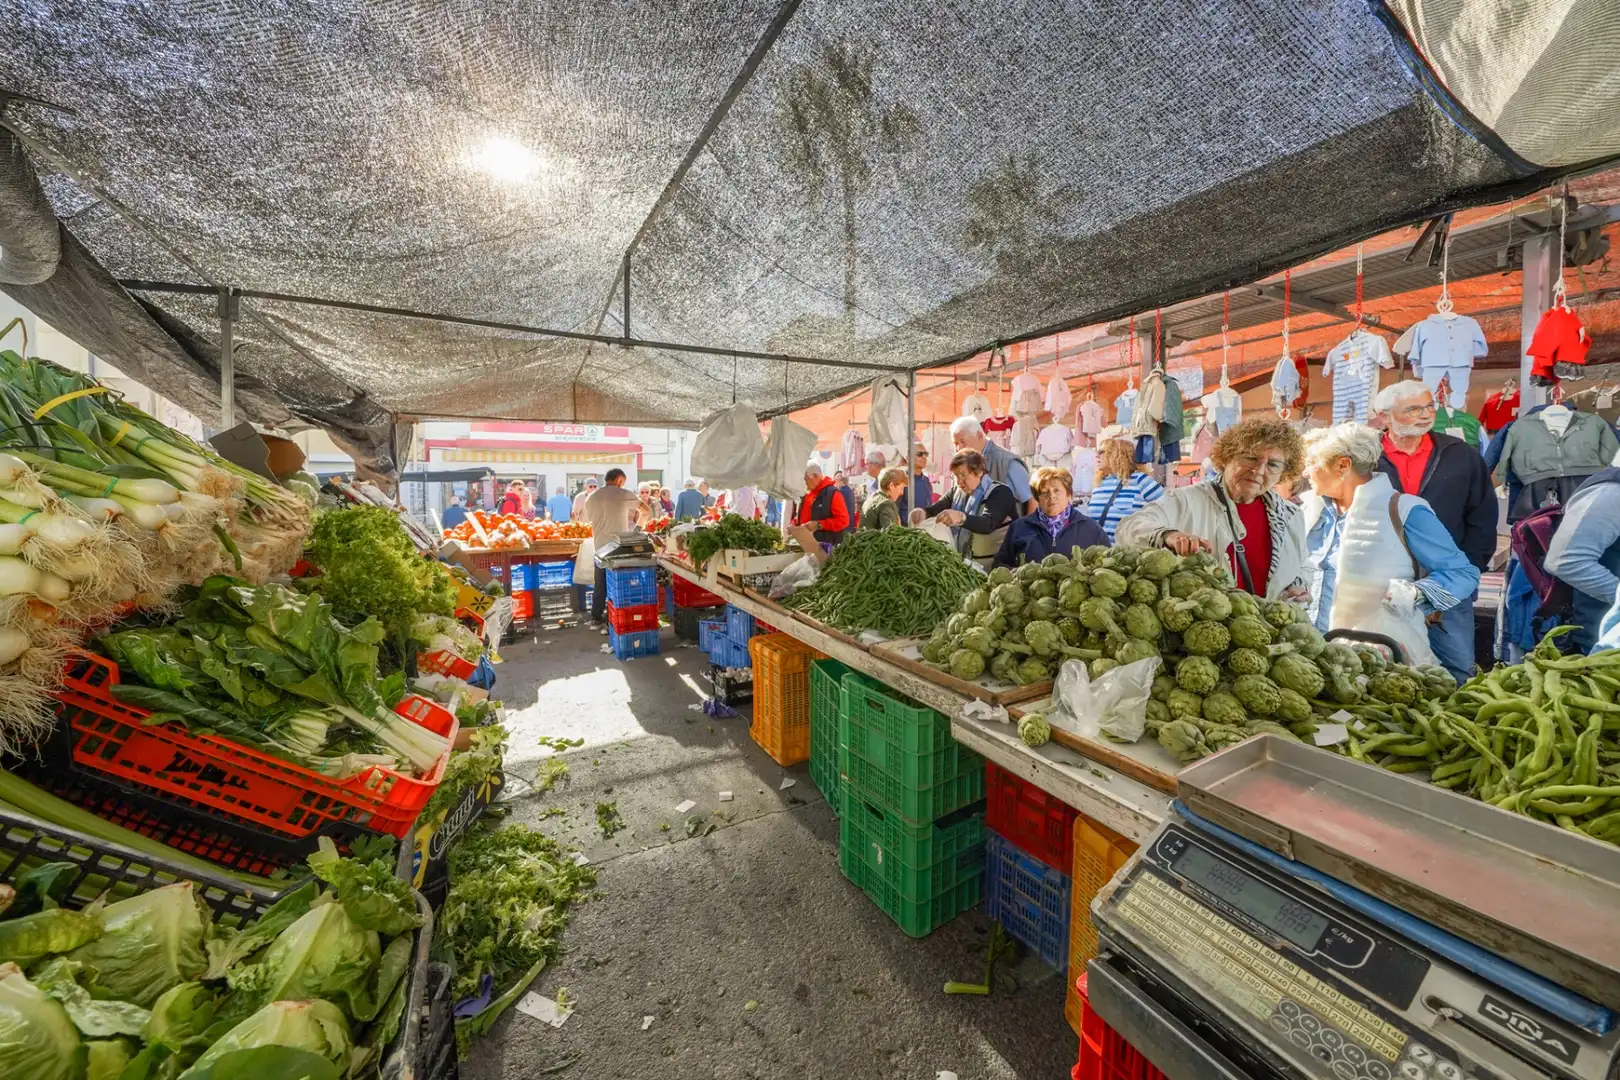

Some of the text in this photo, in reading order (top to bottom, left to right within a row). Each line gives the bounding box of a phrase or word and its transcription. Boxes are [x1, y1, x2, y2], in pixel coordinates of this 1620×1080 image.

[543, 425, 585, 434] SPAR
[1332, 928, 1354, 943] €/kg
[1228, 963, 1242, 975] 370
[1232, 928, 1242, 938] 60
[1248, 940, 1259, 949] 70
[1264, 950, 1276, 960] 80
[1282, 960, 1294, 972] 90
[1320, 984, 1337, 998] 110
[1340, 998, 1358, 1012] 120
[1386, 1026, 1404, 1042] 140
[1220, 940, 1234, 952] 210
[1254, 962, 1269, 974] 230
[1272, 974, 1288, 987] 240
[1292, 986, 1308, 1000] 250
[1310, 1000, 1328, 1014] 260
[1331, 1014, 1350, 1028] 270
[1352, 1028, 1372, 1042] 280
[1376, 1042, 1396, 1058] 290
[1485, 1002, 1569, 1056] DINA
[1408, 1067, 1418, 1076] 4
[1416, 1048, 1455, 1078] 7 8
